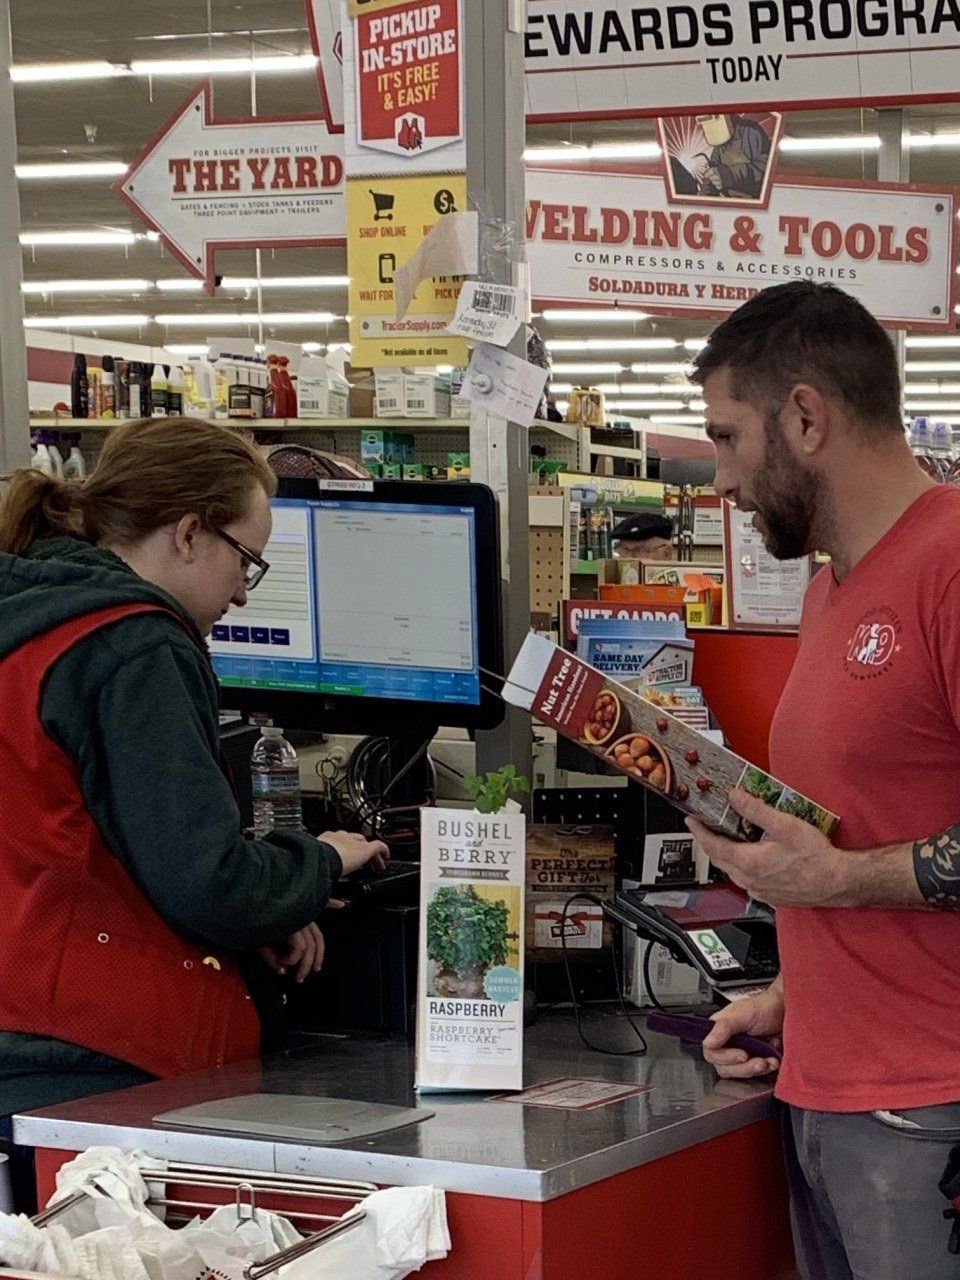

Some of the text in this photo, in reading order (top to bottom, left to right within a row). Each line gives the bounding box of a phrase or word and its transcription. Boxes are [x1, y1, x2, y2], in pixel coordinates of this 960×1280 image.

[369, 4, 441, 43] PICKUP
[362, 29, 456, 73] IN-STORE
[378, 62, 440, 92] IT'S FREE
[706, 53, 783, 84] TODAY
[384, 82, 439, 110] & EASY!
[213, 149, 245, 157] BIGGER
[248, 146, 292, 155] PROJECTS
[295, 145, 318, 153] VISIT
[168, 155, 343, 193] THE YARD
[217, 209, 237, 217] POINT
[239, 208, 278, 216] EQUIPMENT
[288, 207, 320, 215] TRAILERS
[272, 200, 293, 208] TANKS
[303, 199, 333, 207] FEEDERS
[359, 226, 406, 238] SHOP ONLINE
[729, 214, 762, 254] &
[778, 215, 929, 264] TOOLS
[574, 252, 858, 280] COMPRESSORS & ACCESSORIES
[359, 290, 394, 301] WAIT FOR
[434, 288, 452, 300] PICK
[588, 276, 706, 298] SOLDADURA Y
[593, 653, 644, 664] SAME DAY
[541, 658, 572, 715] Nut Tree
[437, 820, 512, 840] BUSHEL
[438, 847, 512, 865] BERRY
[530, 858, 608, 871] PERFECT
[537, 871, 578, 883] GIFT
[430, 1001, 506, 1018] RASPBERRY
[430, 1024, 493, 1036] RASPBERRY
[430, 1033, 499, 1044] SHORTCAKE
